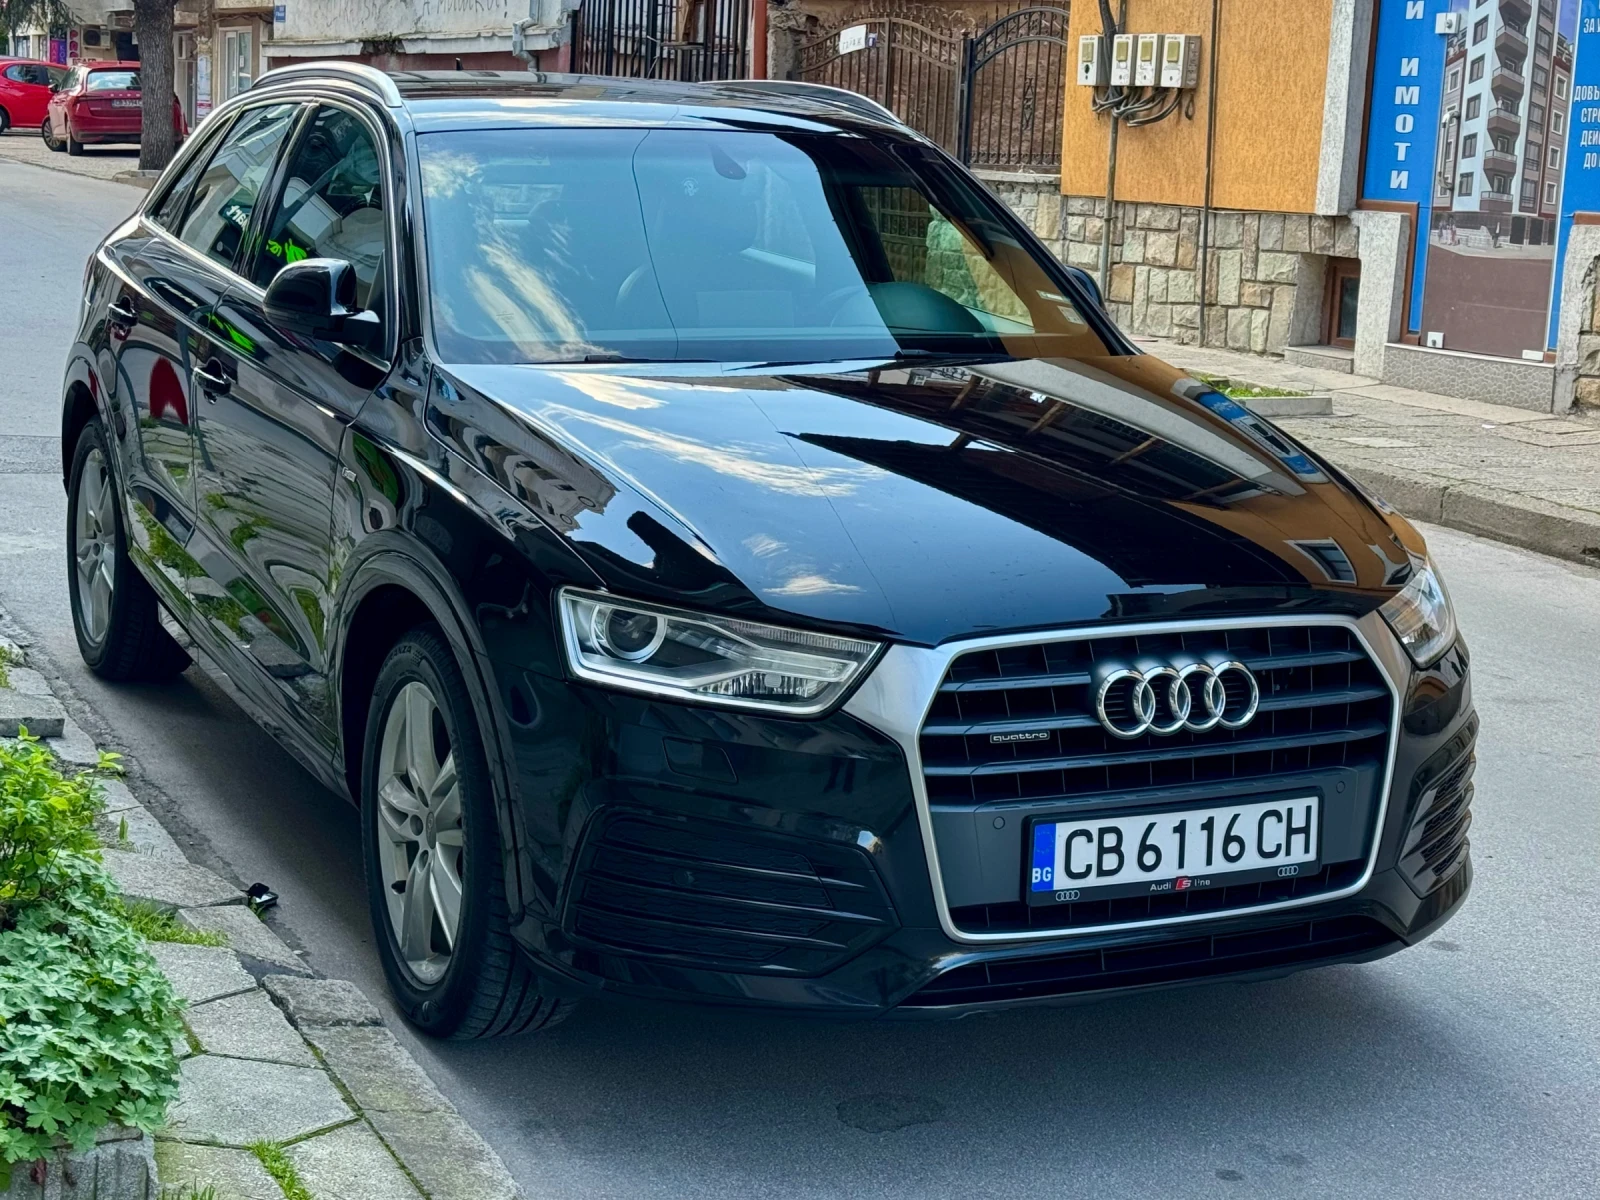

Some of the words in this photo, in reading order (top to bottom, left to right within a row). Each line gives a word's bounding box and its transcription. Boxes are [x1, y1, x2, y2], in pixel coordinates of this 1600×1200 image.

[1583, 17, 1595, 34] ЗА
[1389, 57, 1420, 189] ИМОТИ
[1580, 127, 1600, 147] ДЕЙ
[1583, 152, 1597, 170] ДО
[993, 732, 1048, 742] quattro
[1064, 826, 1125, 880] CB
[1137, 813, 1246, 872] 6116
[1257, 804, 1313, 859] CH
[1031, 867, 1052, 883] BG
[1149, 881, 1172, 892] Audi
